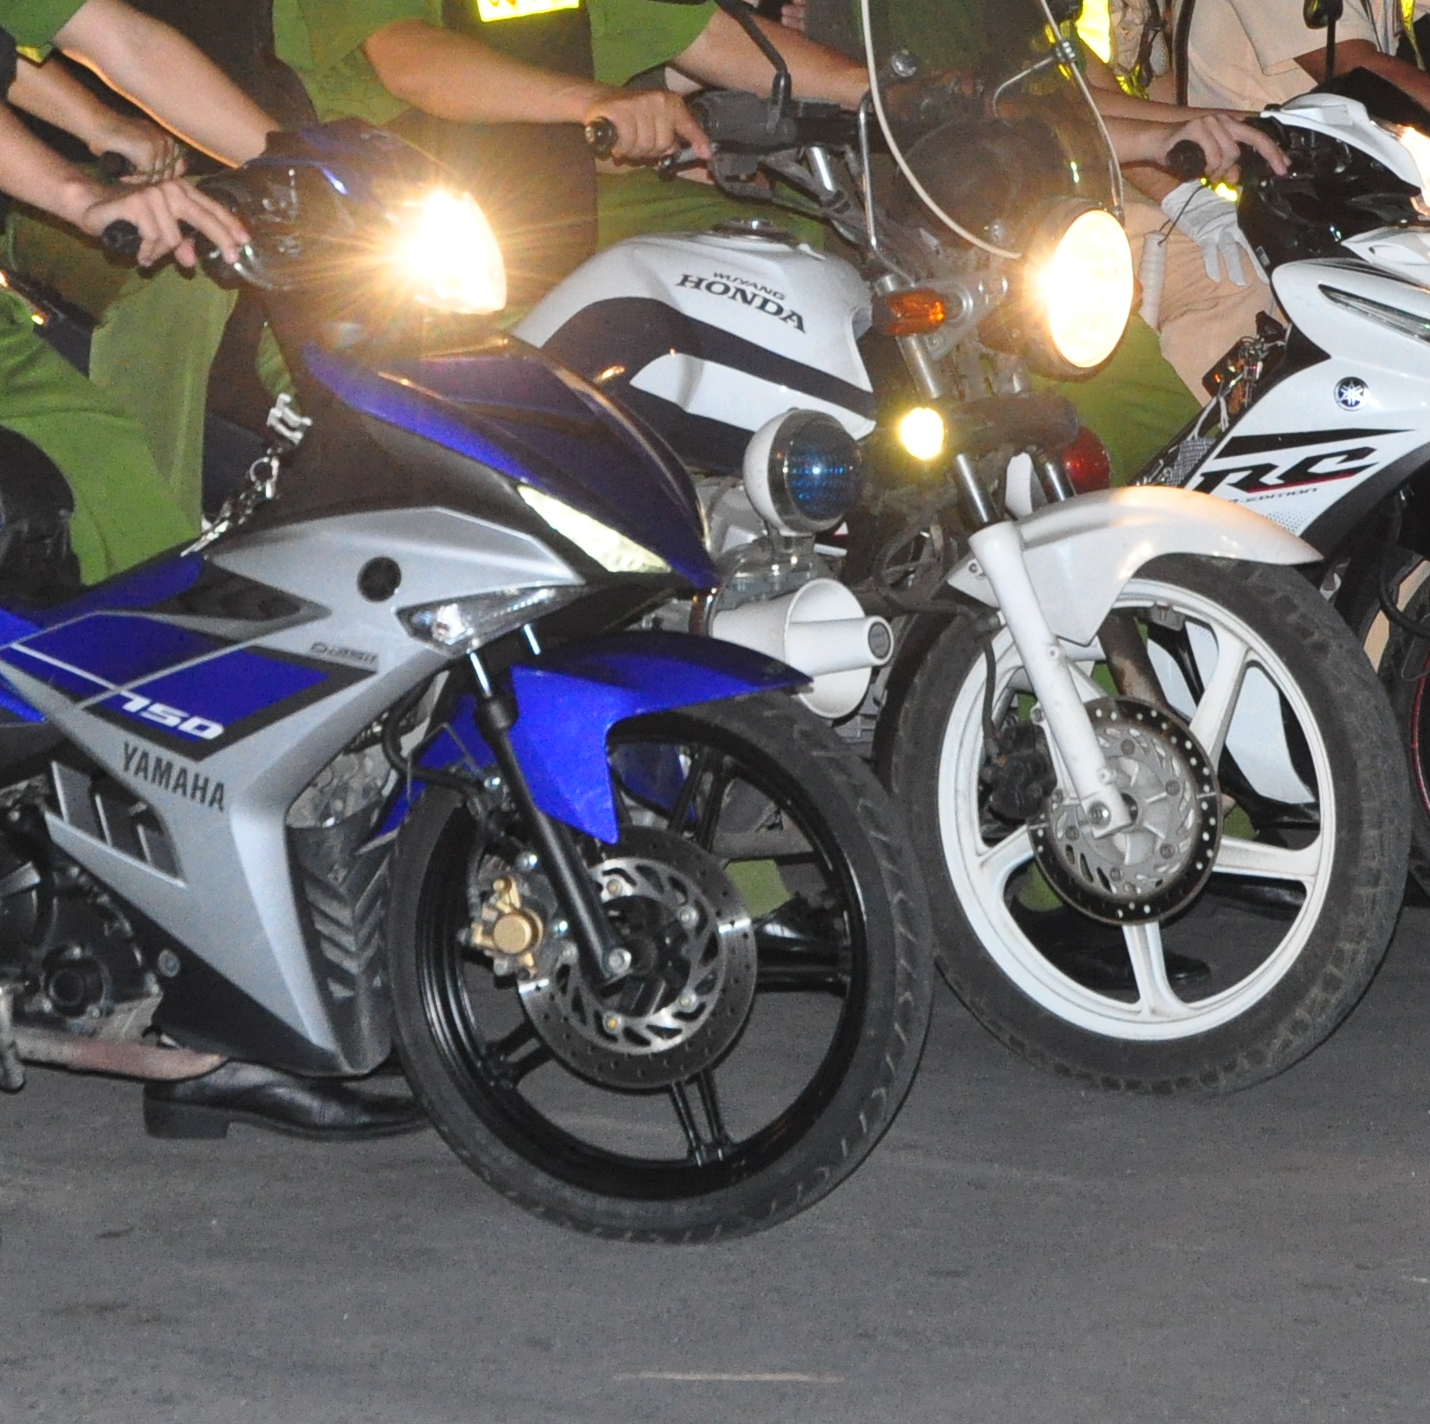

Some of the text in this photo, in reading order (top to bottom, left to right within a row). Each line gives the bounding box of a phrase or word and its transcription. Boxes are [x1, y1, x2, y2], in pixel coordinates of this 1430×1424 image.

[676, 274, 806, 334] HONDA
[713, 272, 786, 301] WUYANG
[123, 742, 224, 810] YAMAHA
